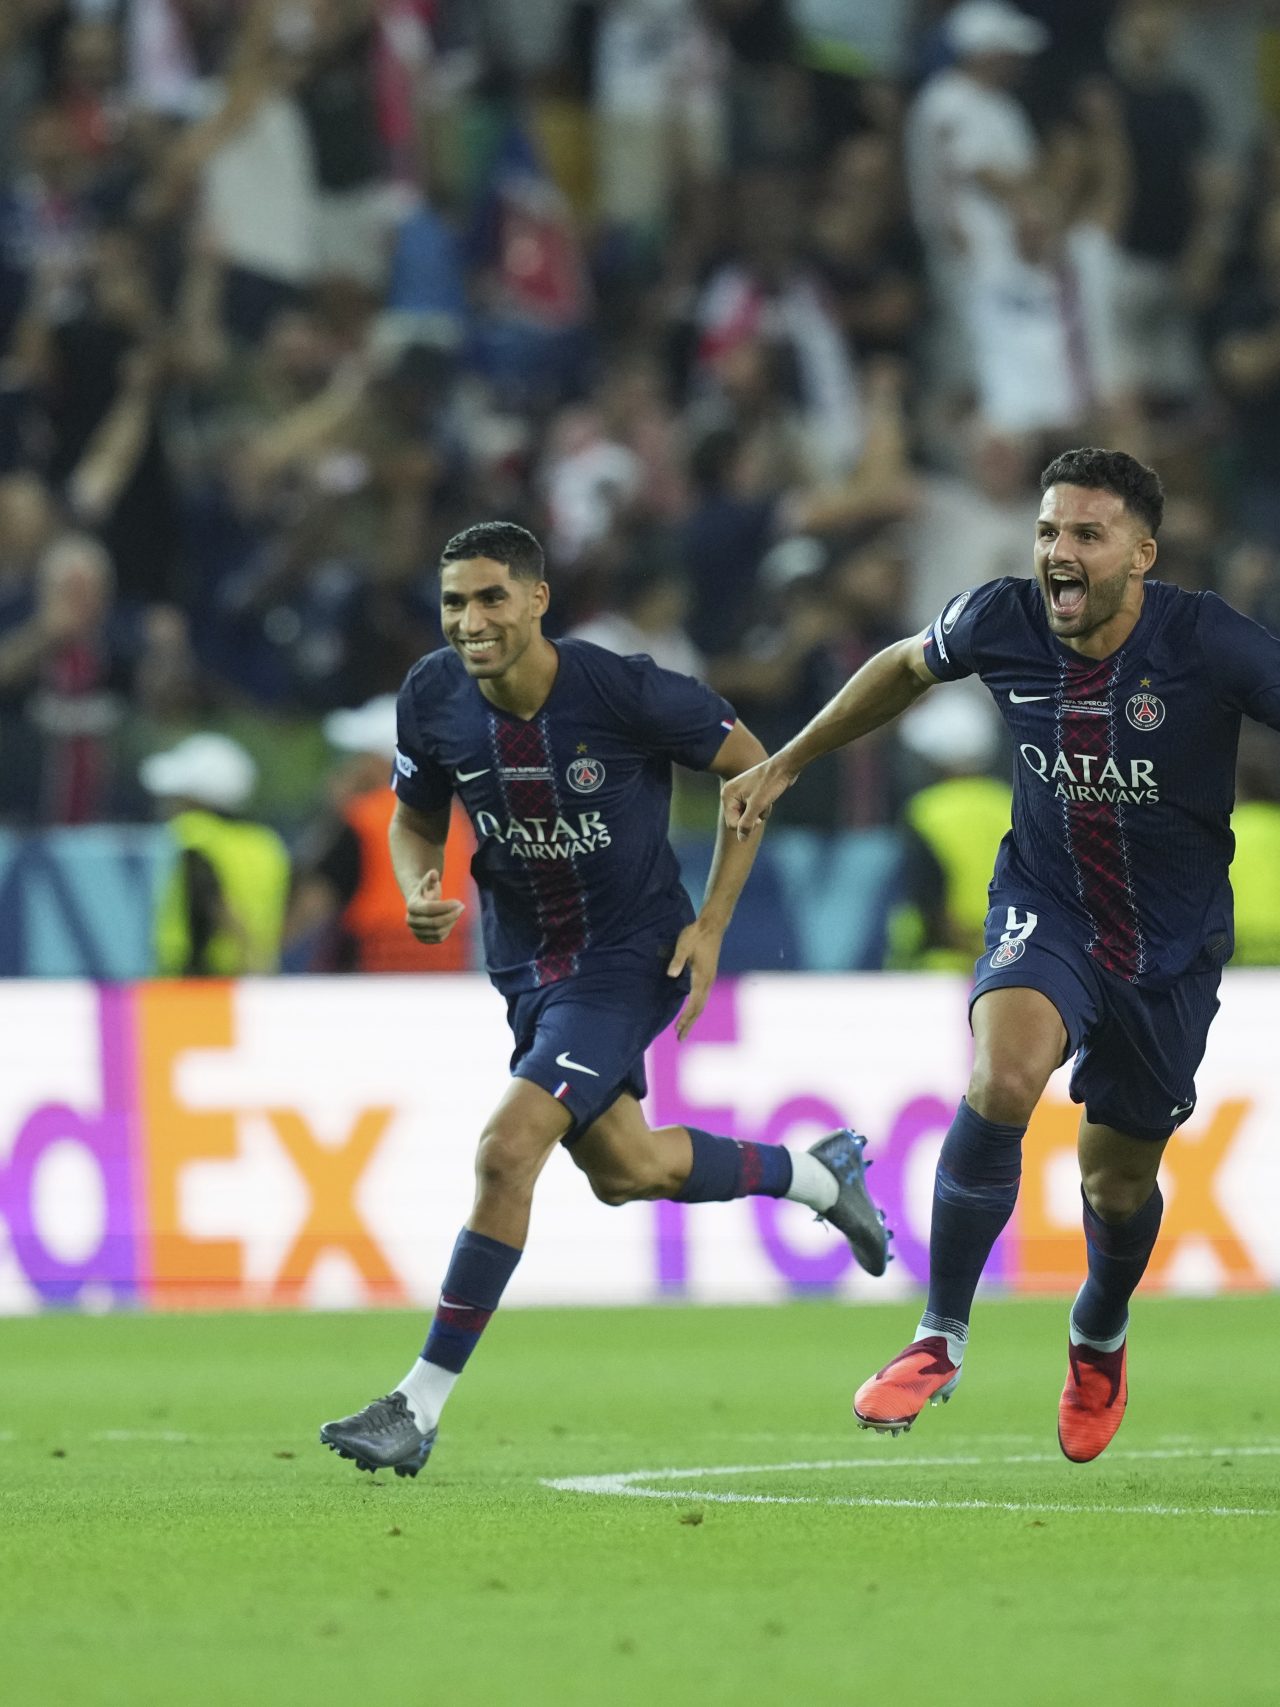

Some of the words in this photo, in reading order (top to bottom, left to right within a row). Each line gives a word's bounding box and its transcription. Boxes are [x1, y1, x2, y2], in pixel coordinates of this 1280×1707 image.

[1131, 694, 1157, 704] PARIS
[1020, 743, 1158, 788] QATAR
[1055, 783, 1159, 805] AIRWAYS
[476, 811, 607, 843] QATAR
[510, 830, 611, 860] AIRWAYS
[1000, 906, 1037, 943] 9
[0, 980, 412, 1306] dEx
